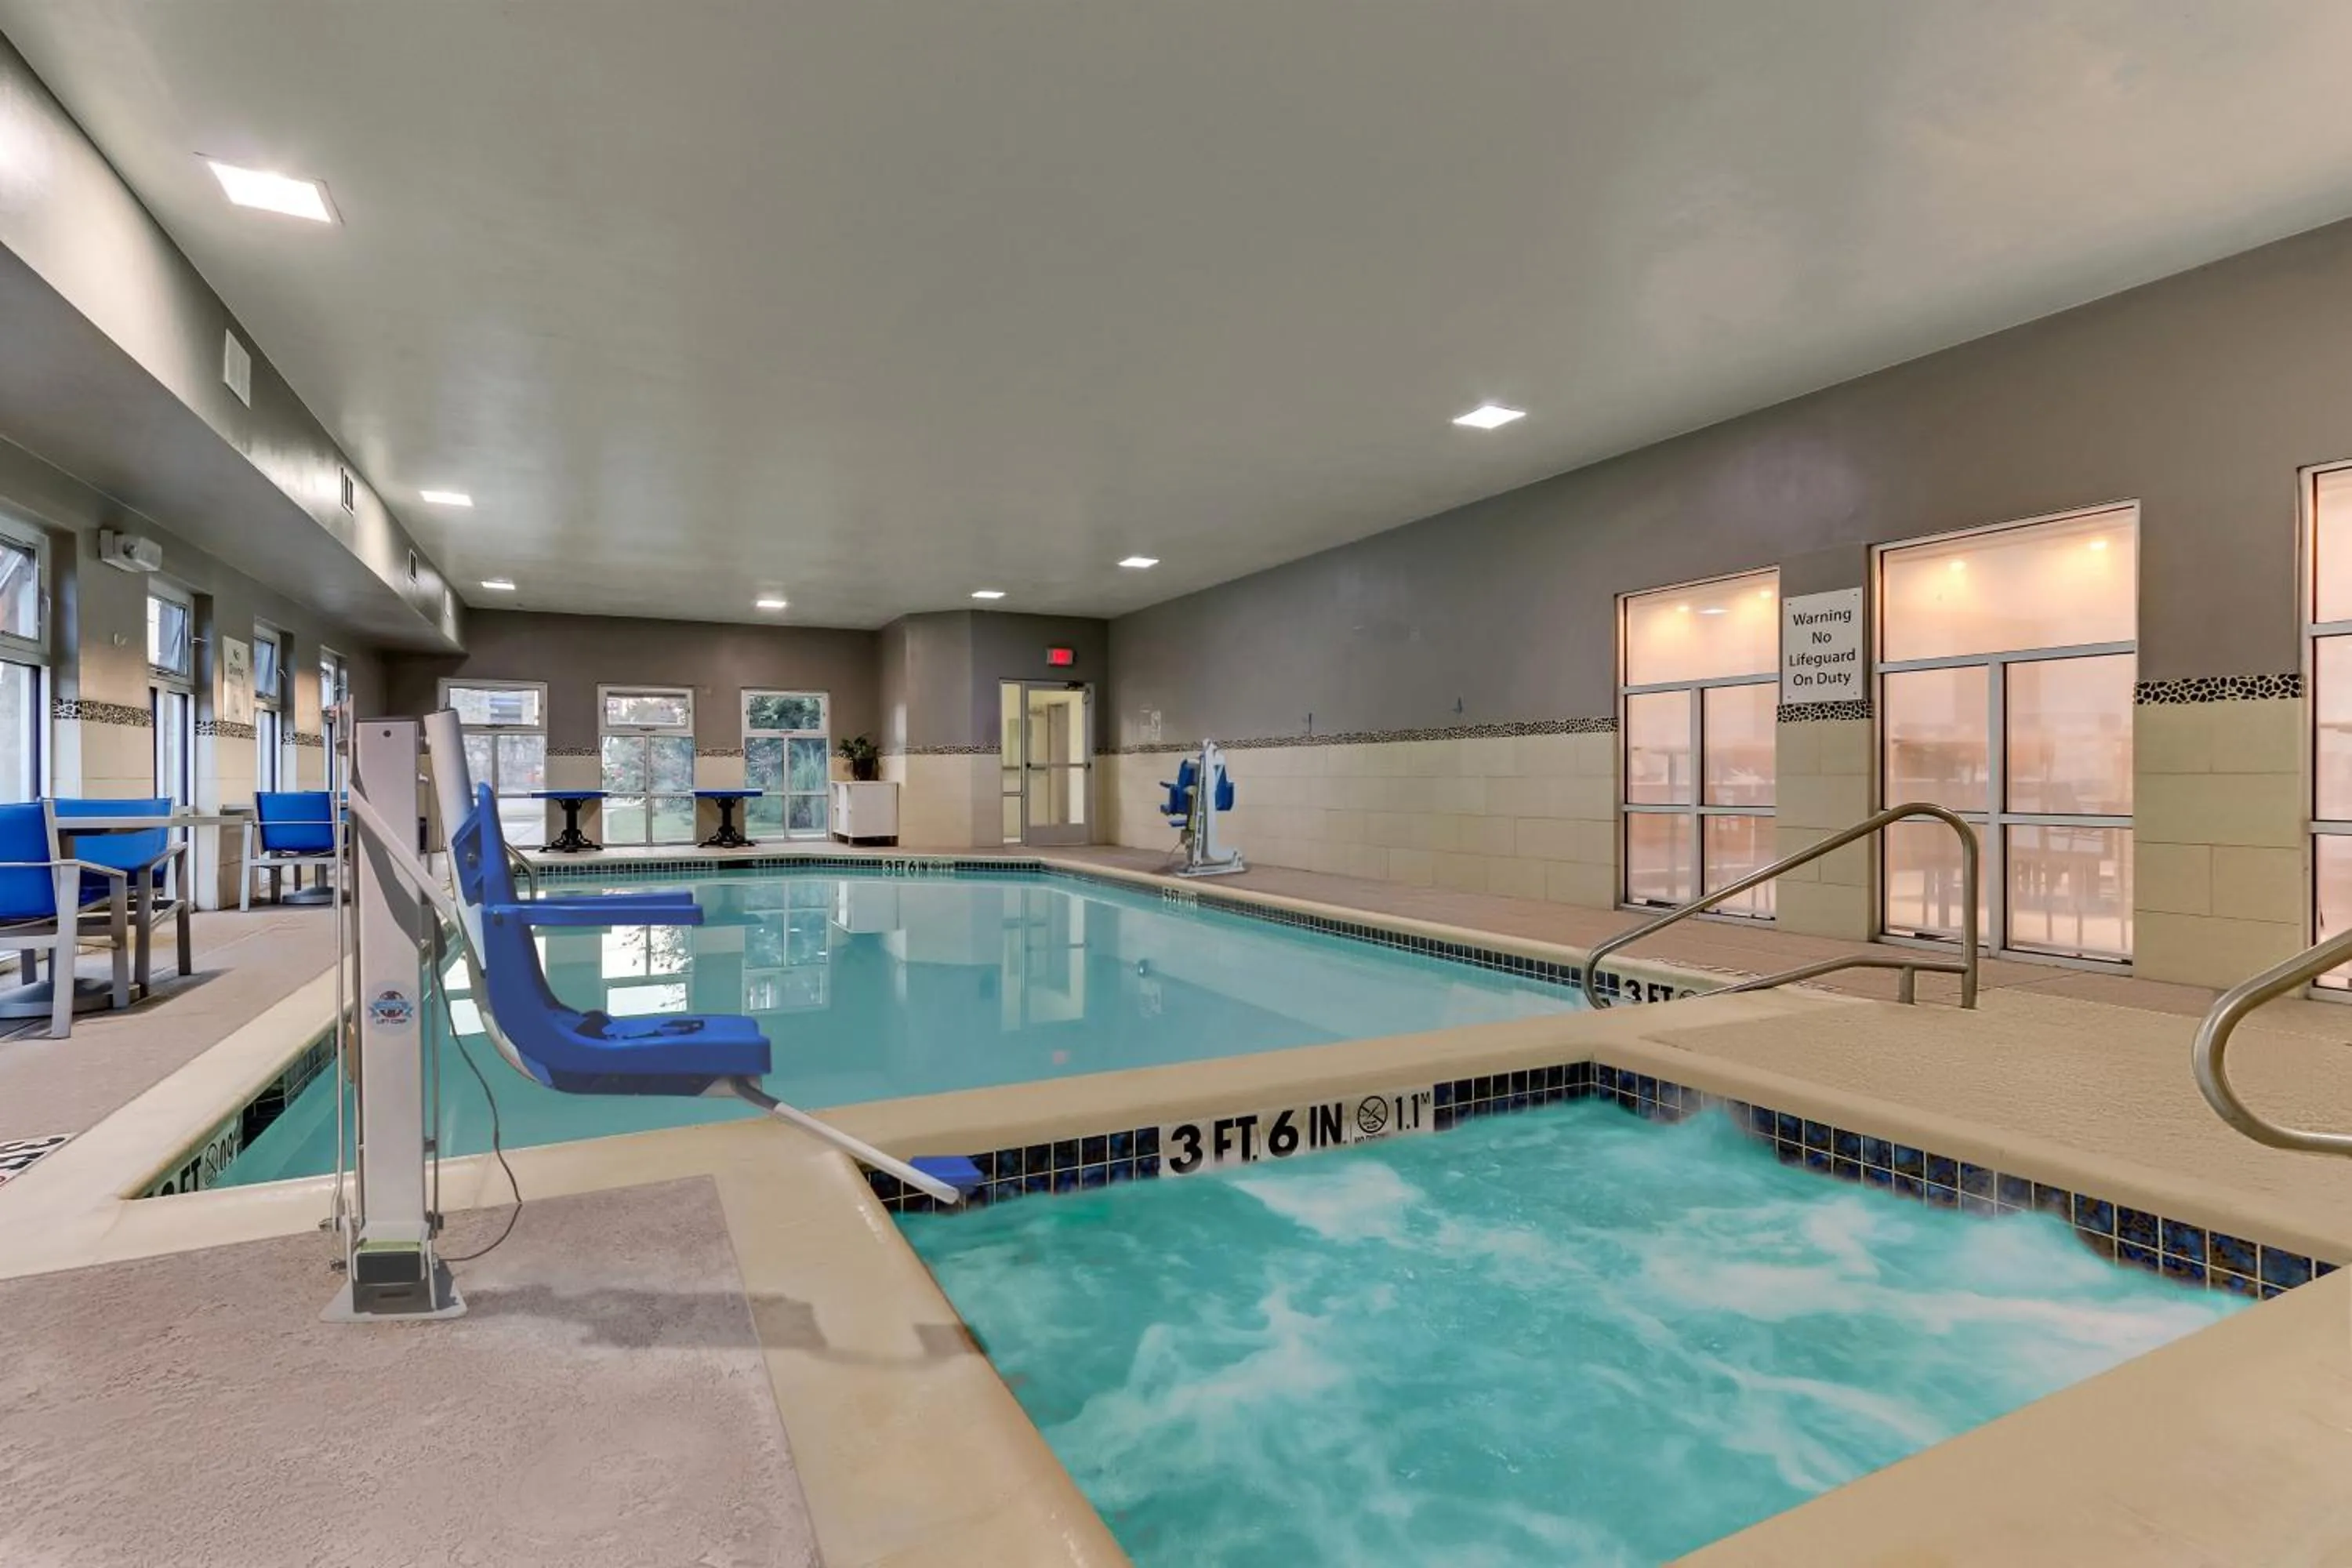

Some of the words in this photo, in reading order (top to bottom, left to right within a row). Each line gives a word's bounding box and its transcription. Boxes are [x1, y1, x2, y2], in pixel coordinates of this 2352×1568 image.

[1793, 609, 1852, 626] Warning
[1812, 631, 1832, 644] No
[1789, 648, 1856, 667] Lifeguard
[1793, 673, 1813, 686] On
[1817, 672, 1852, 685] Duty
[1624, 979, 1642, 1004] 3
[1647, 982, 1674, 1004] FT
[1169, 1123, 1203, 1174] 3
[1268, 1109, 1299, 1158] 6
